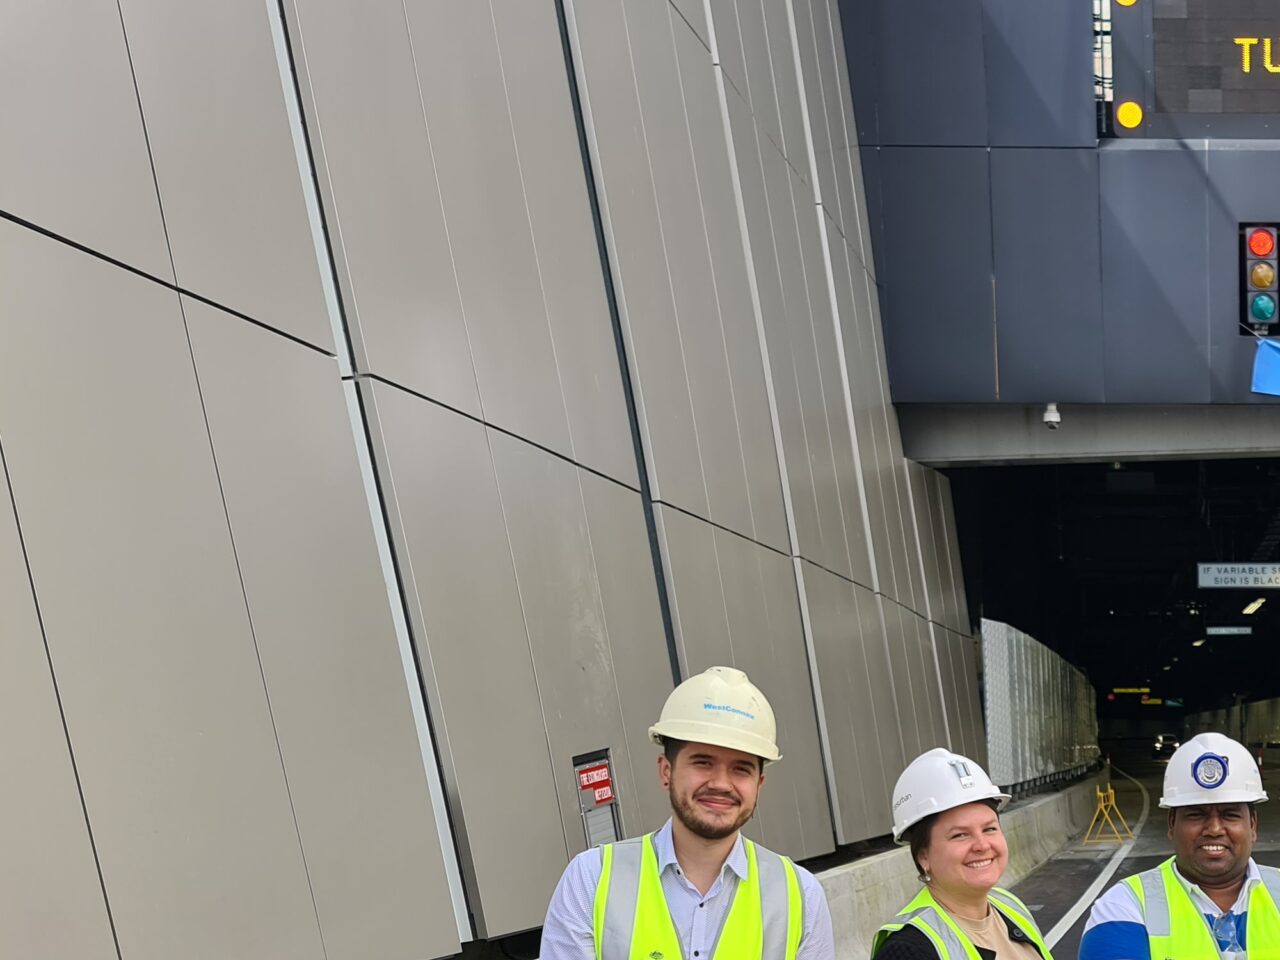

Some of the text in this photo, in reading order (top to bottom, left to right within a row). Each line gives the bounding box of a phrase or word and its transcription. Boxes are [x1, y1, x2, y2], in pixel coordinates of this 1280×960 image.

[1202, 566, 1212, 575] IF
[1216, 566, 1268, 575] VARIABLE
[1213, 577, 1237, 585] SIGN
[1240, 577, 1250, 585] IS
